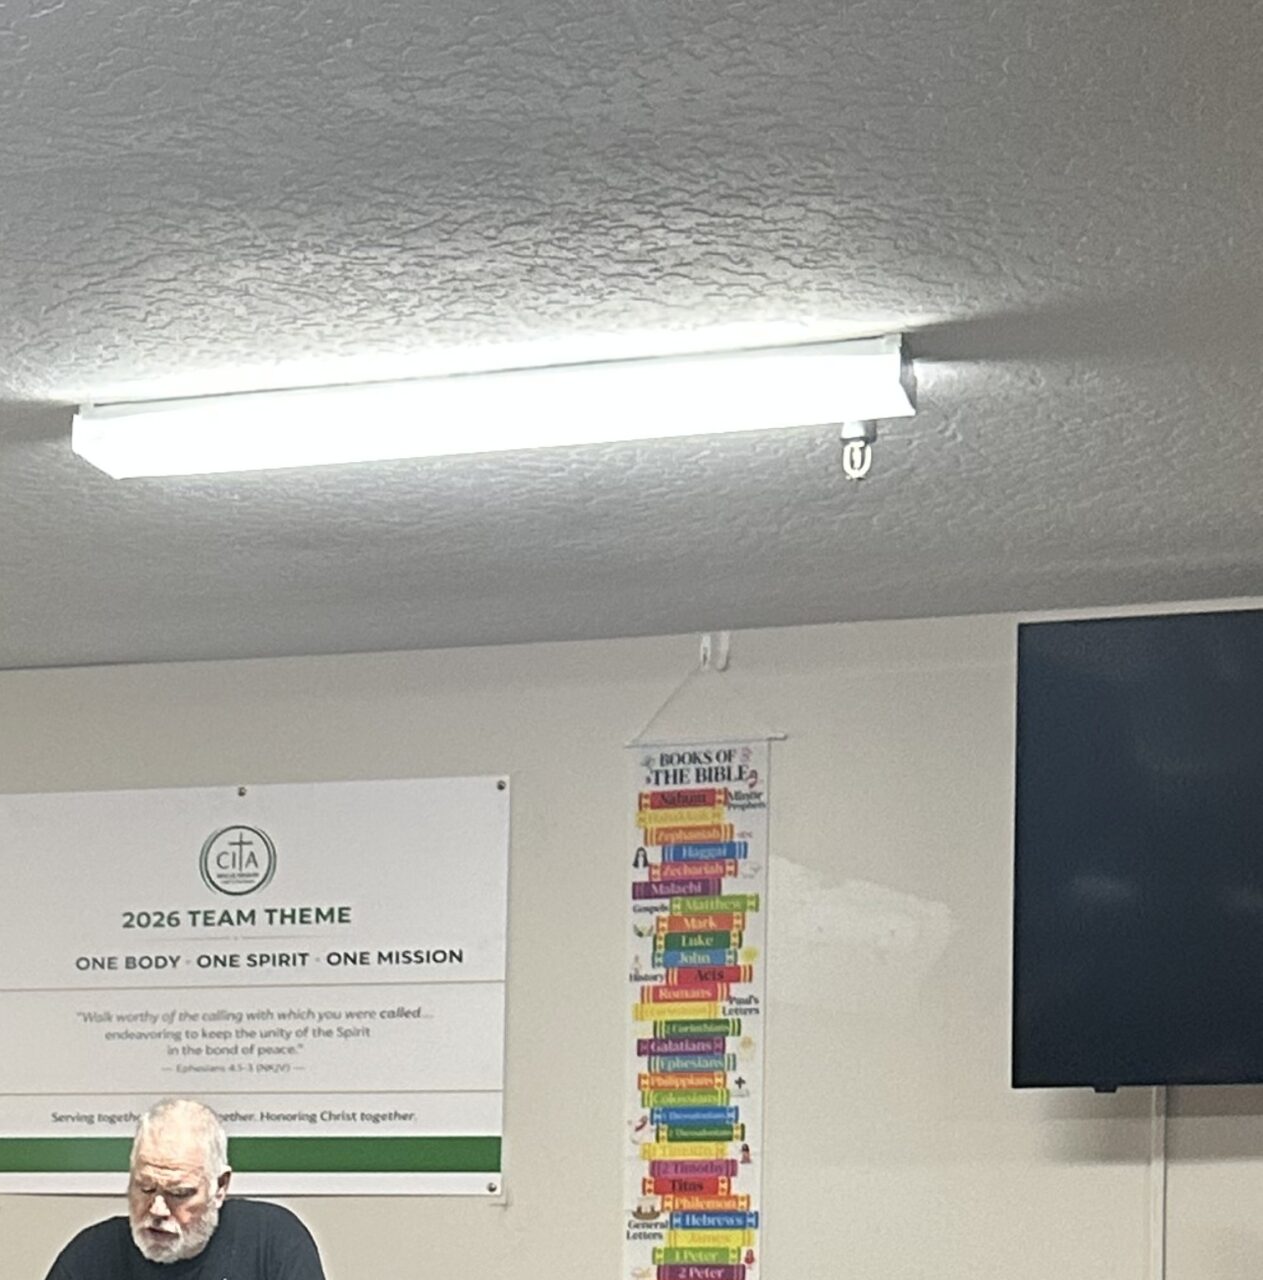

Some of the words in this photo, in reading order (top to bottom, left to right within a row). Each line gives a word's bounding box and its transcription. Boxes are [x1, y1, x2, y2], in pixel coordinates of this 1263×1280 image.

[658, 750, 713, 767] BOOKS
[715, 748, 737, 764] OF
[651, 767, 691, 786] THE
[694, 764, 749, 784] BIBLE
[122, 911, 181, 928] 2026
[187, 909, 256, 927] TEAM
[264, 906, 352, 925] THEME
[681, 935, 715, 948] Luke
[75, 956, 118, 971] ONE
[124, 955, 181, 970] BODY
[196, 953, 240, 969] ONE
[246, 952, 310, 968] SPIRIT
[326, 951, 371, 967] ONE
[377, 949, 464, 965] MISSION
[679, 950, 711, 965] John
[116, 1010, 159, 1024] worthy
[161, 1009, 177, 1024] of
[178, 1011, 199, 1022] the
[201, 1009, 243, 1023] calling
[246, 1009, 274, 1021] with
[277, 1008, 316, 1021] which
[318, 1010, 342, 1023] you
[345, 1010, 377, 1020] were
[104, 1028, 182, 1042] endeavoring
[185, 1029, 199, 1040] to
[201, 1028, 233, 1041] keep
[235, 1028, 257, 1039] the
[259, 1027, 292, 1041] unity
[295, 1026, 310, 1038] of
[312, 1026, 334, 1038] the
[336, 1026, 371, 1040] Spirit
[167, 1045, 179, 1055] in
[181, 1044, 202, 1055] the
[205, 1044, 238, 1055] bond
[241, 1043, 255, 1055] of
[650, 1038, 713, 1053] Galatians
[51, 1112, 96, 1125] Serving
[259, 1110, 317, 1124] Honoring
[320, 1110, 358, 1122] Christ
[360, 1110, 418, 1124] together.
[684, 1213, 745, 1227] Hebrews
[678, 1267, 687, 1280] 2
[689, 1266, 725, 1280] Peter
